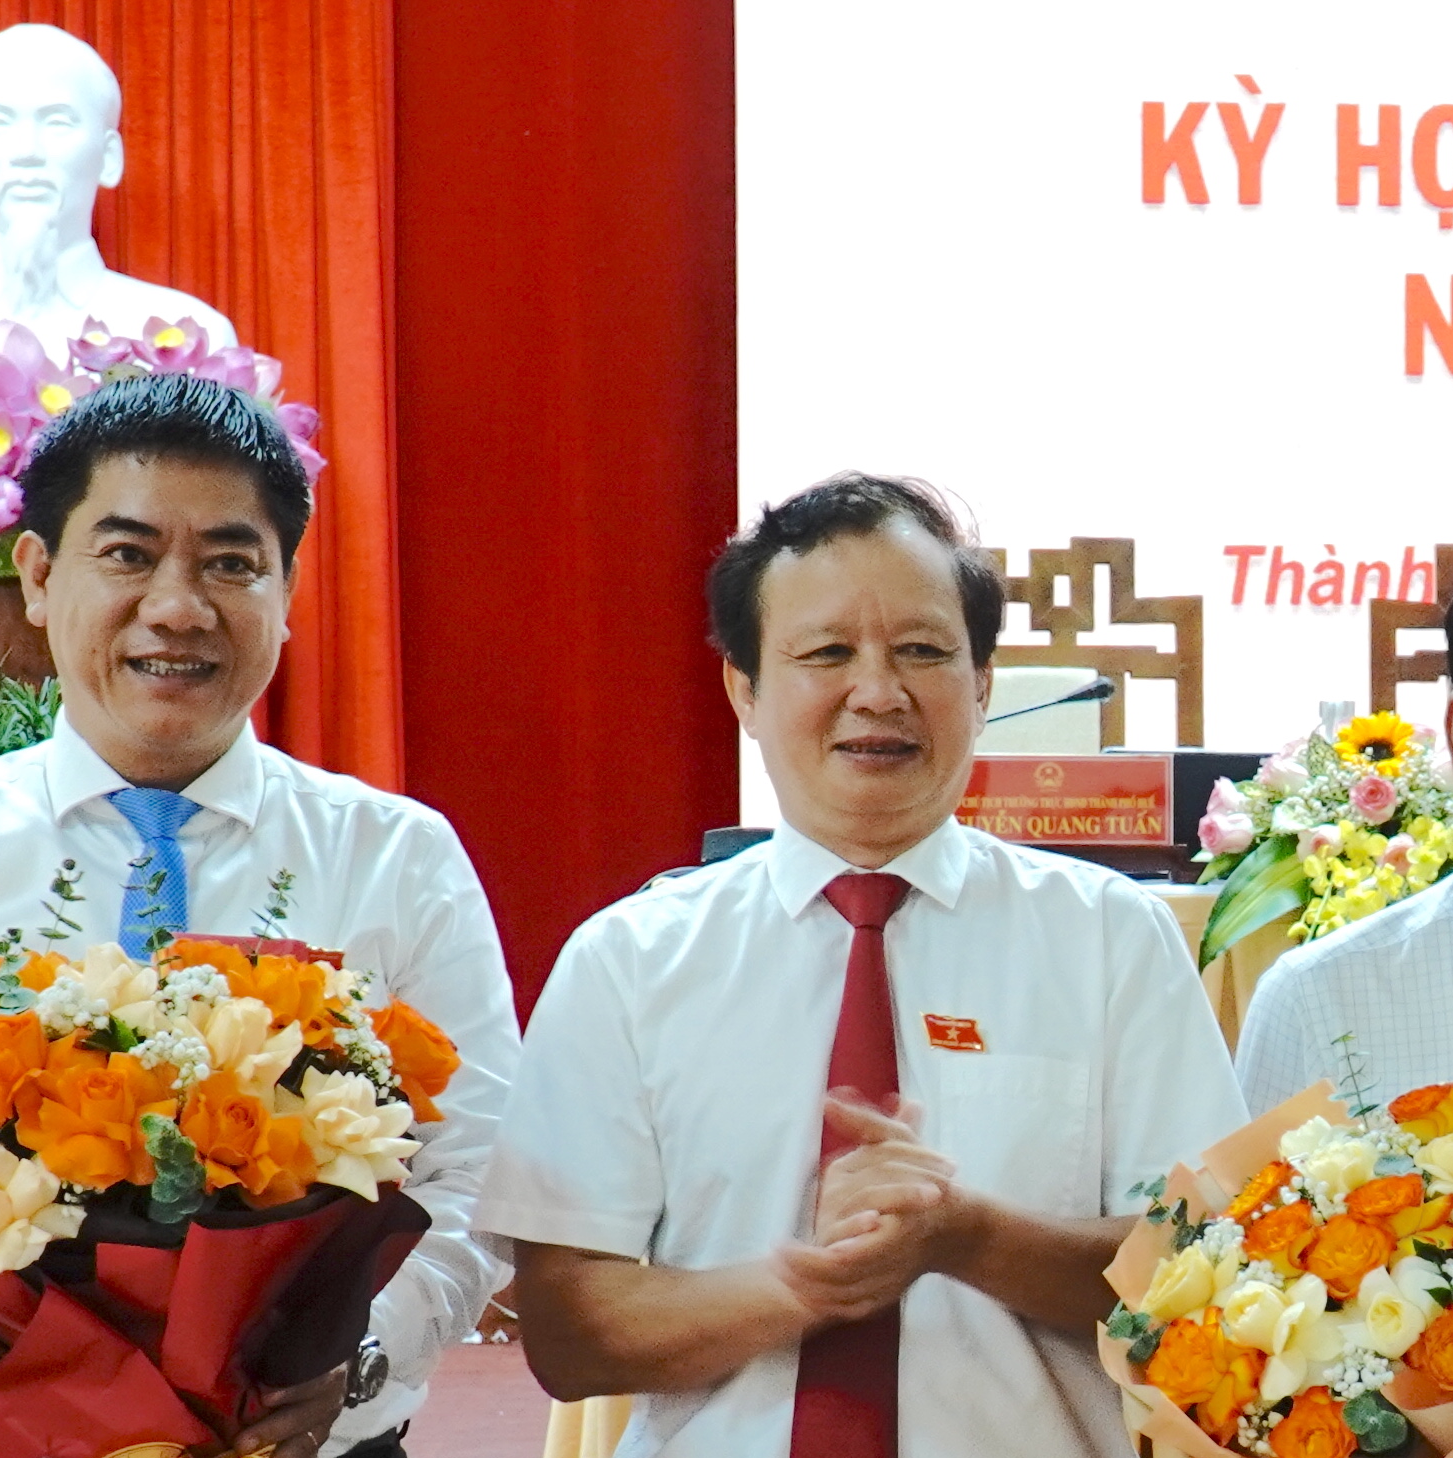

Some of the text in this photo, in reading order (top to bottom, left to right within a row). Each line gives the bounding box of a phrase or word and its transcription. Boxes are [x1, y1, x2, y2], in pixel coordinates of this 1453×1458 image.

[1142, 75, 1284, 205] KỲ
[1225, 544, 1435, 606] Thành
[1026, 815, 1100, 838] QUANG
[1104, 809, 1162, 835] TUẤN
